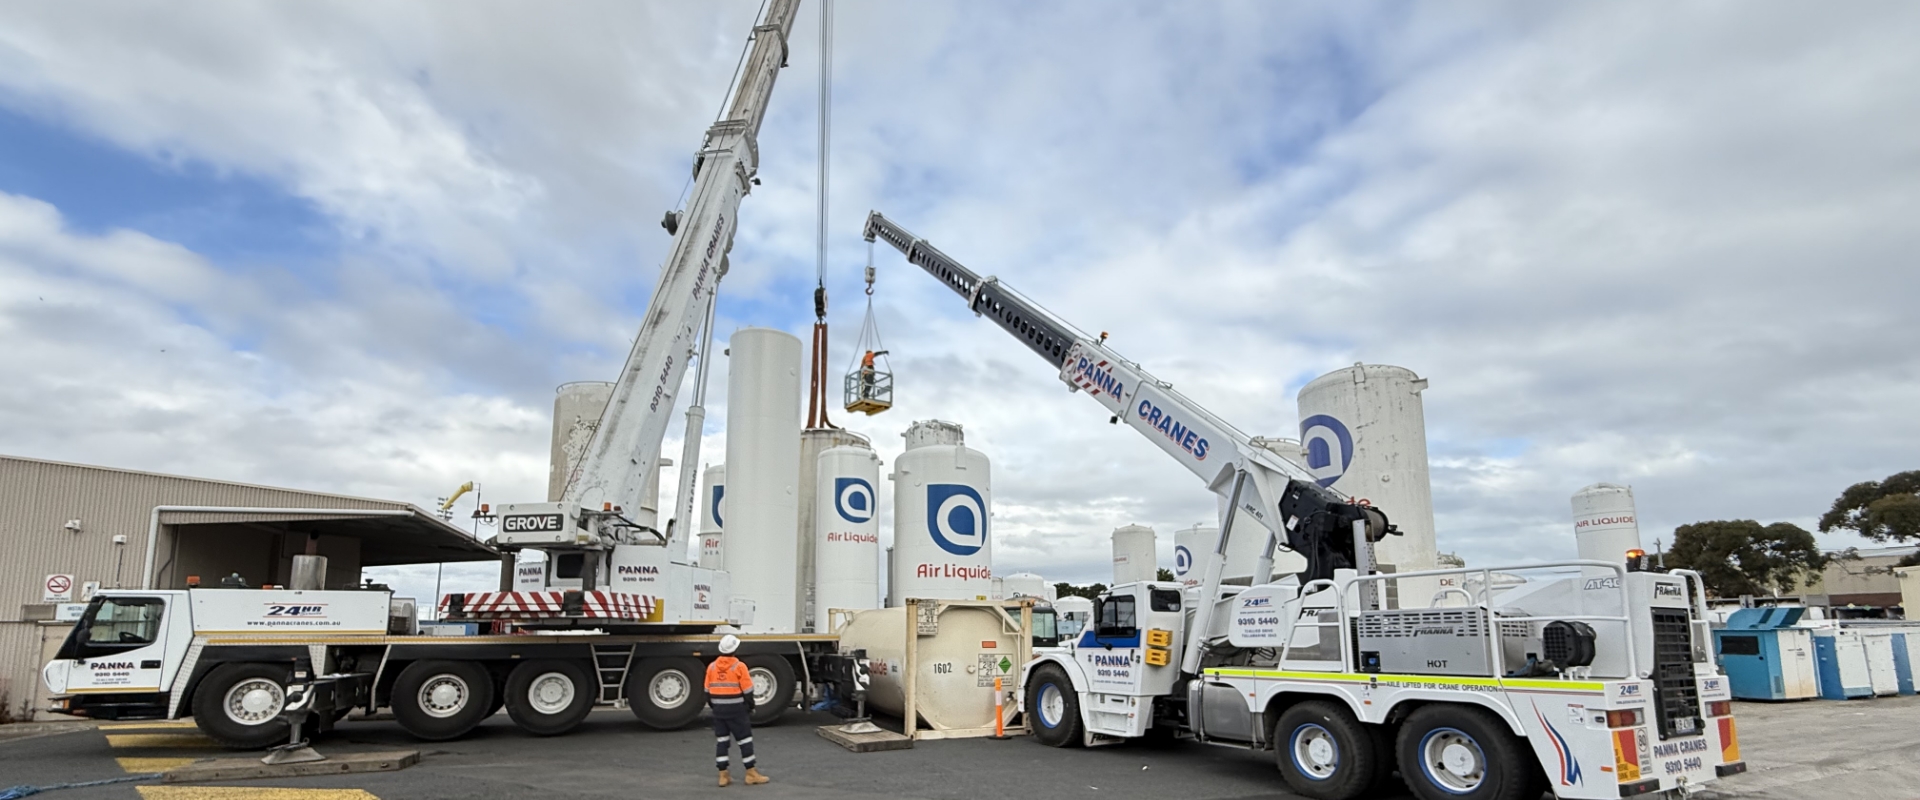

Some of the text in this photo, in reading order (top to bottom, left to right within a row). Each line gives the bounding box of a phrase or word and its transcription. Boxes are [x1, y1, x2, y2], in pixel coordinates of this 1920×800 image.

[692, 213, 725, 300] PANNA CRANES
[650, 355, 673, 412] 9310 5440
[1077, 357, 1210, 460] PANNA CRANES
[505, 516, 558, 530] GROVE
[1576, 516, 1634, 528] AIR LIQUIDE
[704, 538, 720, 548] Air
[827, 532, 878, 544] Air Liquide
[518, 566, 542, 576] PANNA
[618, 566, 659, 574] PANNA
[917, 564, 992, 581] Air Liquide
[1238, 616, 1279, 626] 9310 5440
[90, 662, 136, 670] PANNA
[1095, 655, 1131, 668] PANNA
[1427, 660, 1448, 668] HOT
[934, 662, 952, 674] 1602
[1113, 670, 1130, 678] 5440
[1463, 684, 1498, 692] OPERATION
[1654, 738, 1708, 758] PANNA CRANES
[1665, 760, 1682, 774] 9310
[1684, 757, 1702, 770] 5440
